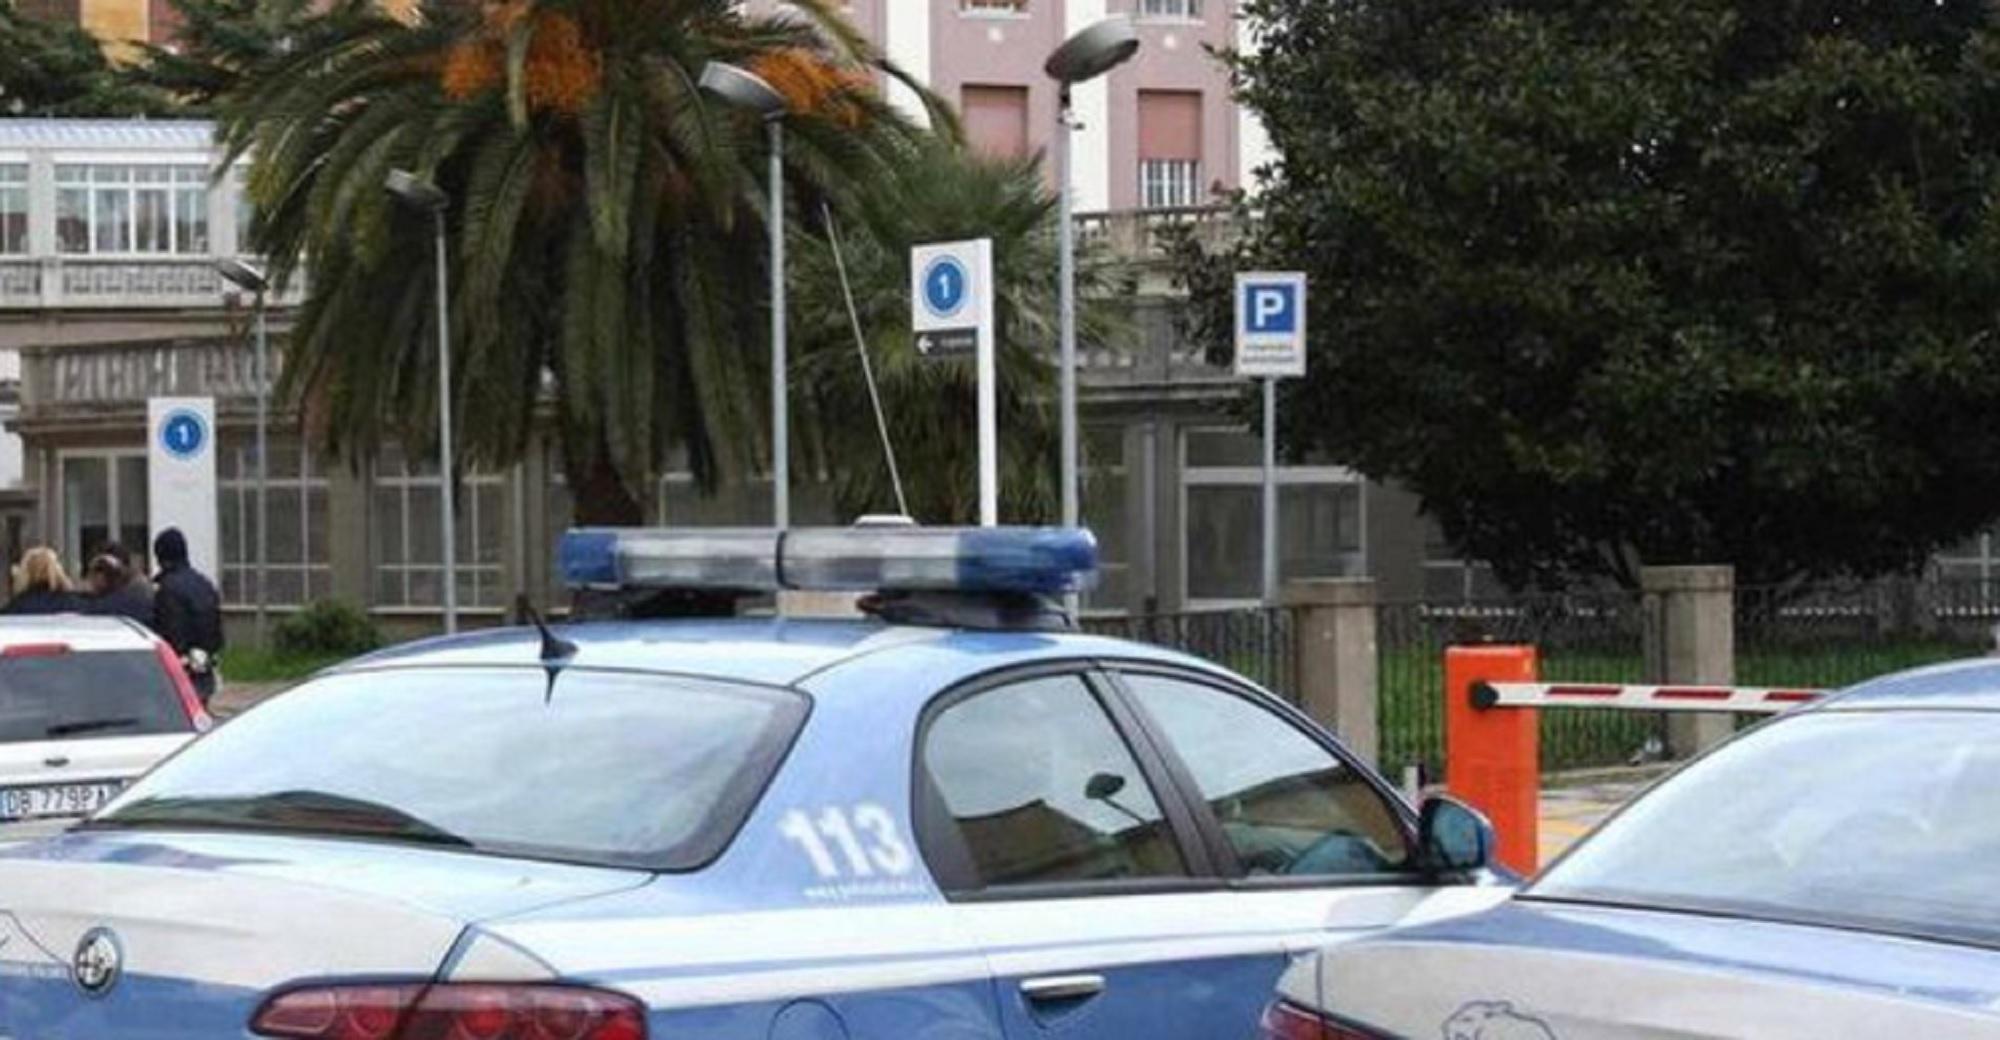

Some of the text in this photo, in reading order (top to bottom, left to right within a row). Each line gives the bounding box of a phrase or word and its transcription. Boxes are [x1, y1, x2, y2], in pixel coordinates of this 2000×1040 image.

[938, 273, 950, 299] 1
[1255, 289, 1285, 328] P
[178, 424, 189, 444] 1
[778, 804, 914, 876] 113
